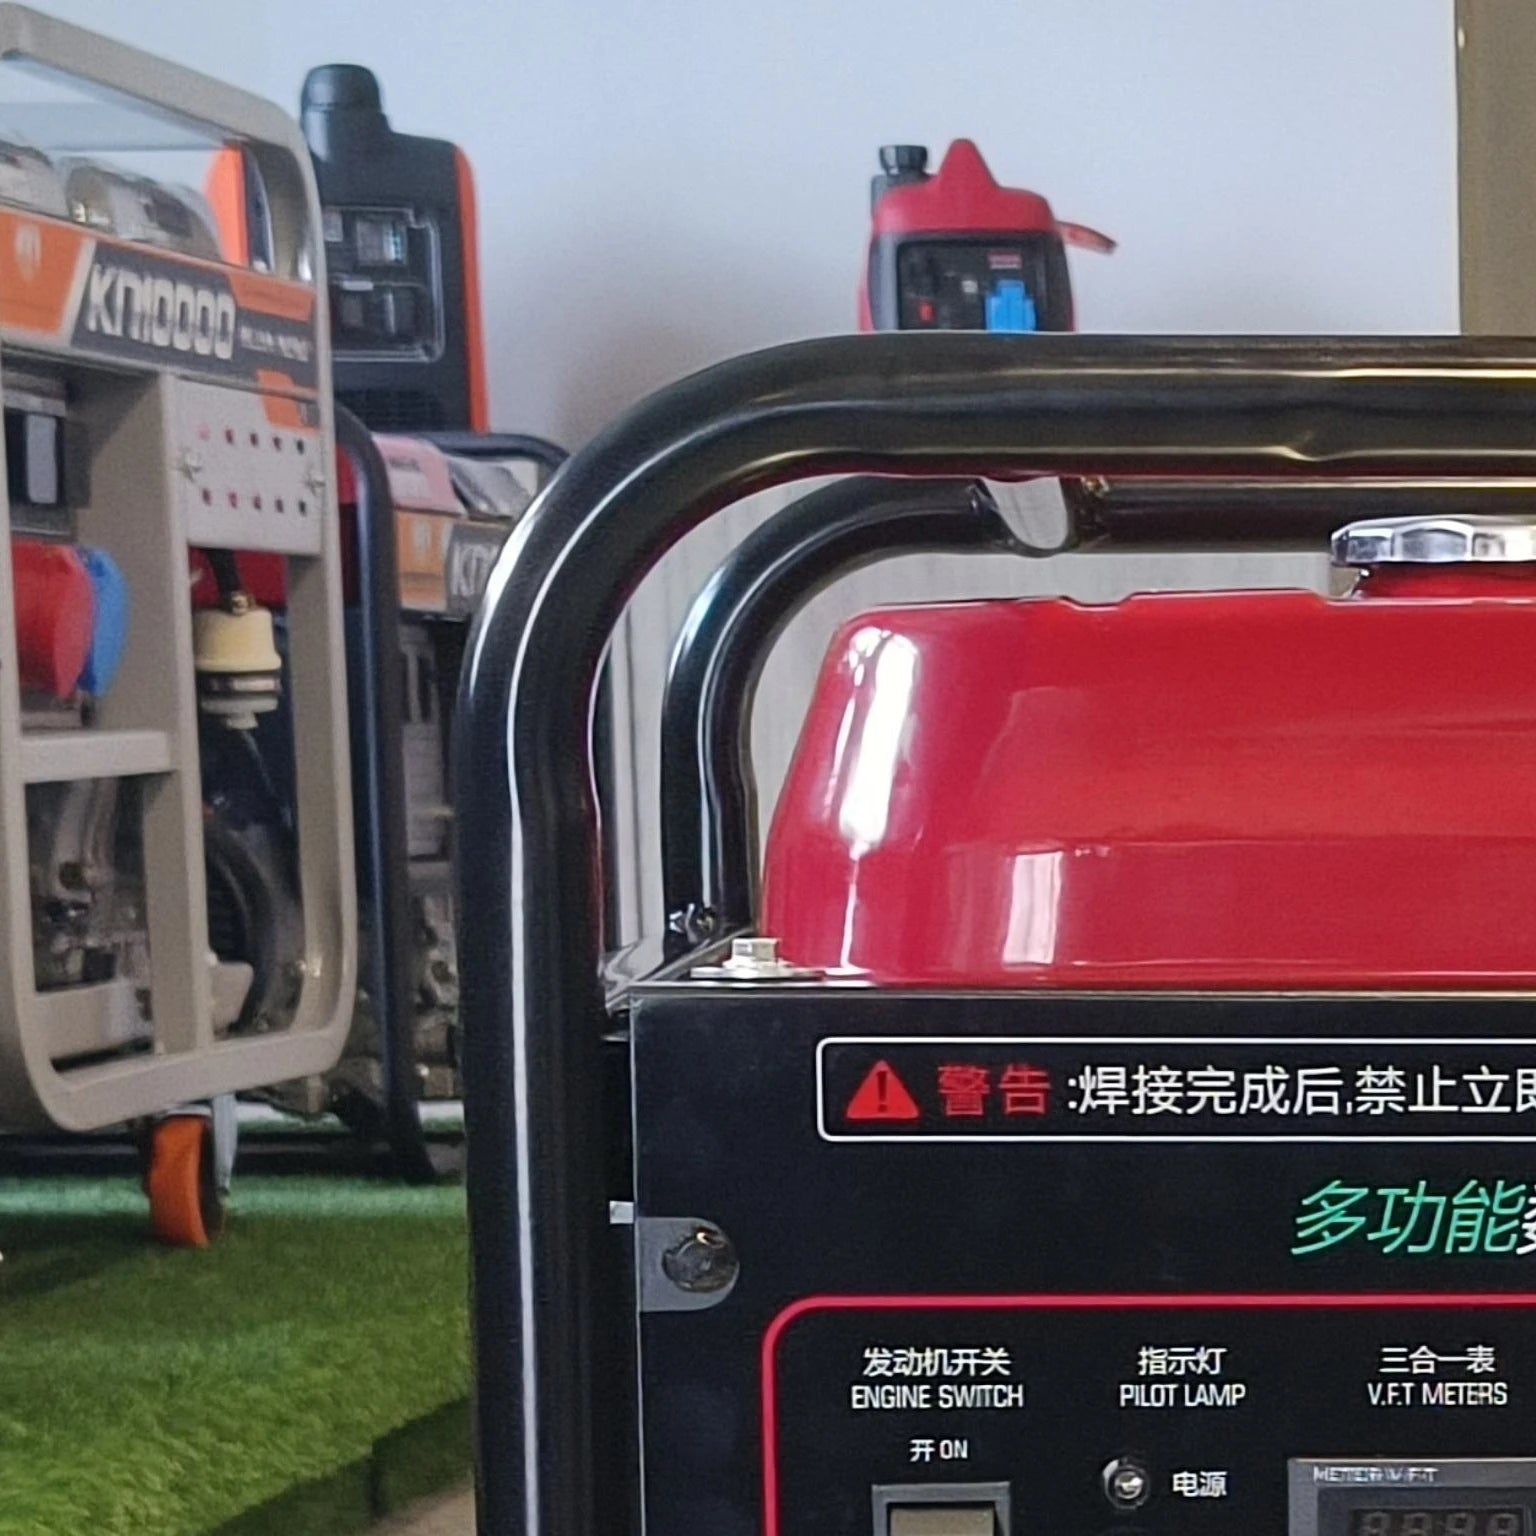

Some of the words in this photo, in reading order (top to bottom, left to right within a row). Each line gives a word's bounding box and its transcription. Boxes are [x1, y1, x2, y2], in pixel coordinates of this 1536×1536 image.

[936, 1063, 1051, 1119] 警告
[863, 1347, 1012, 1377] 发动机开关
[1138, 1346, 1227, 1376] 指示灯
[1379, 1345, 1496, 1375] 三合一表
[851, 1386, 931, 1409] ENGINE
[938, 1384, 1024, 1408] SWITCH
[1119, 1384, 1177, 1407] PILOT
[1184, 1384, 1246, 1407] LAMP
[1421, 1382, 1508, 1406] METERS
[909, 1440, 935, 1461] 开
[940, 1440, 968, 1459] ON
[1172, 1472, 1227, 1497] 电源
